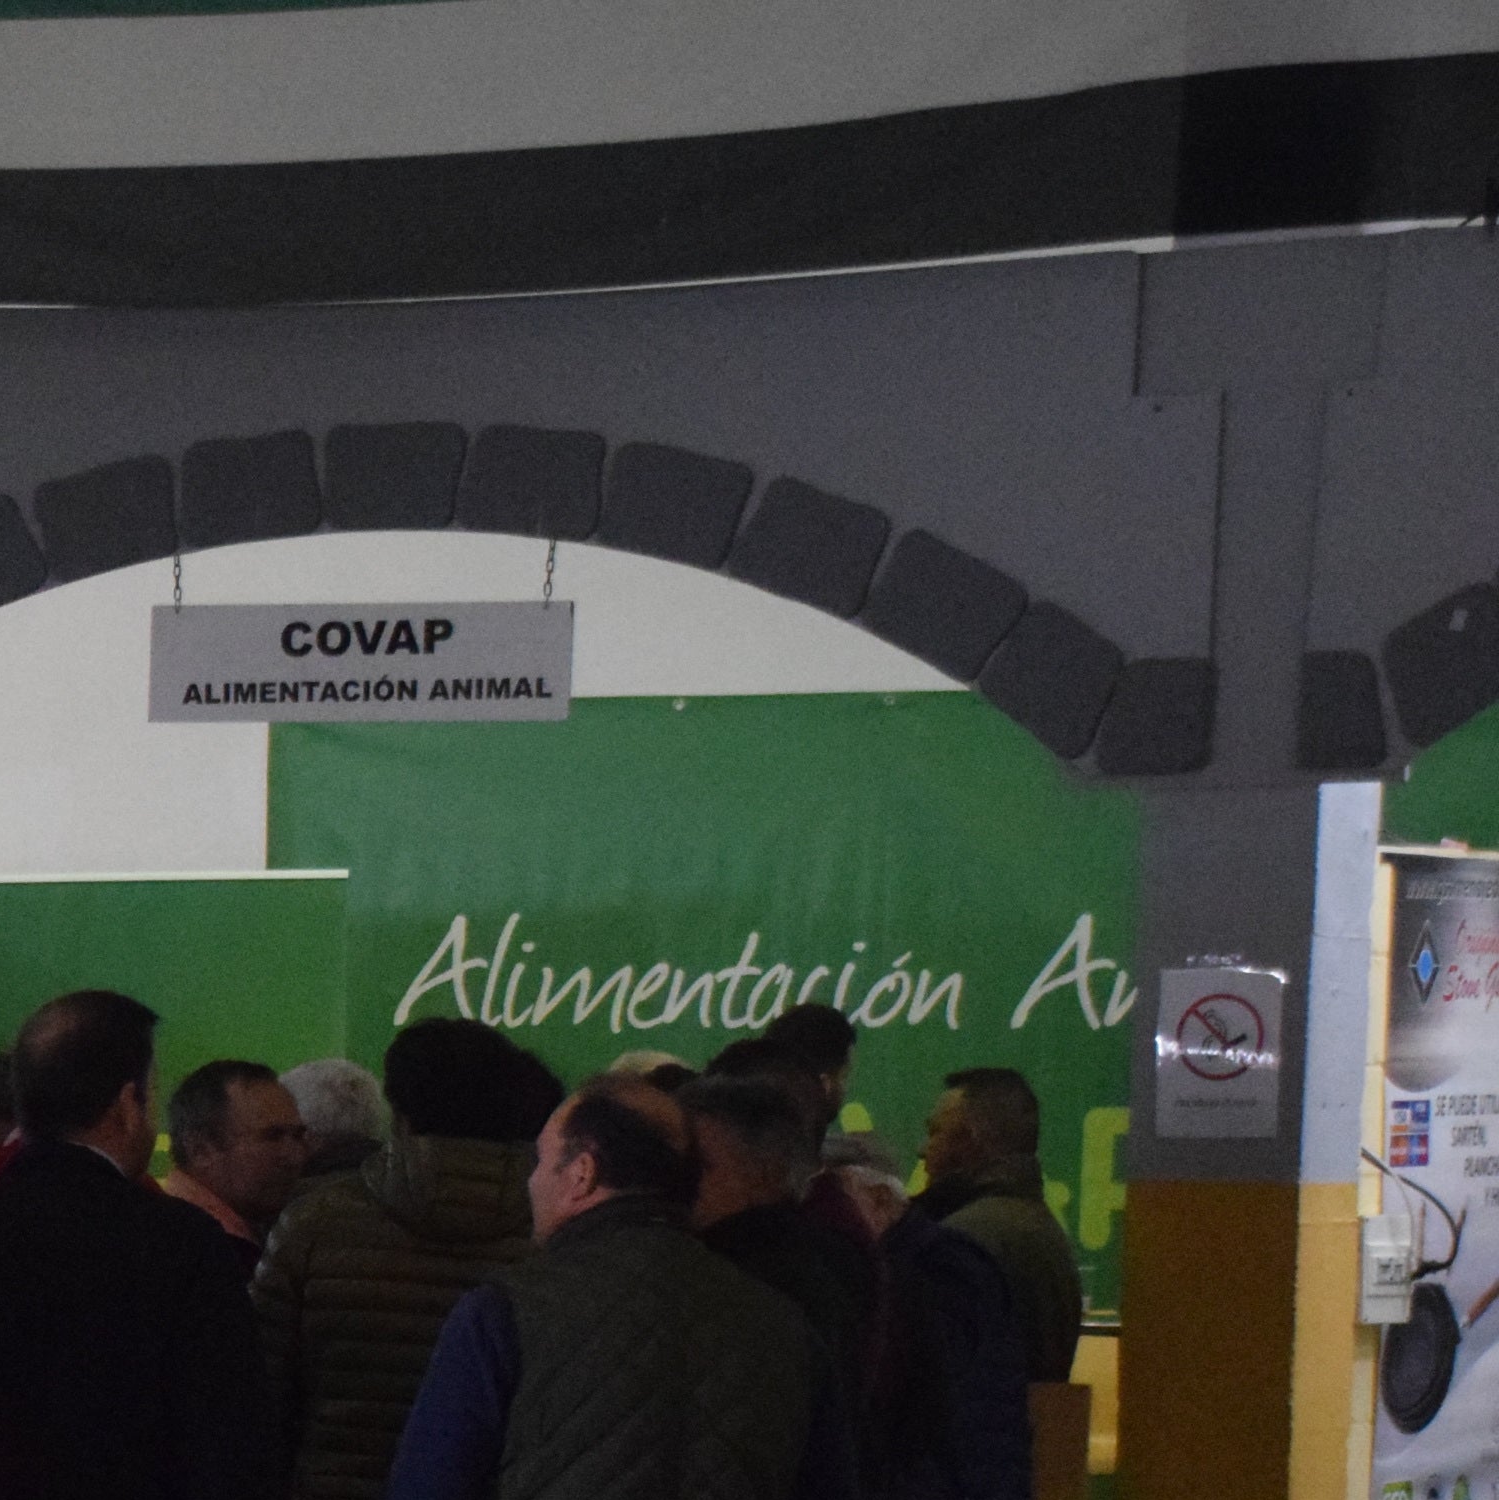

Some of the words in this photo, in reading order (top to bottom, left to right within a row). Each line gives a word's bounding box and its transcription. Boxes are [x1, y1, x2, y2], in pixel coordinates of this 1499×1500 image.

[280, 619, 454, 657] COVAP
[183, 674, 418, 705] ALIMENTACIÓN
[429, 677, 552, 700] ANIMAL
[393, 912, 965, 1034] Alimentación
